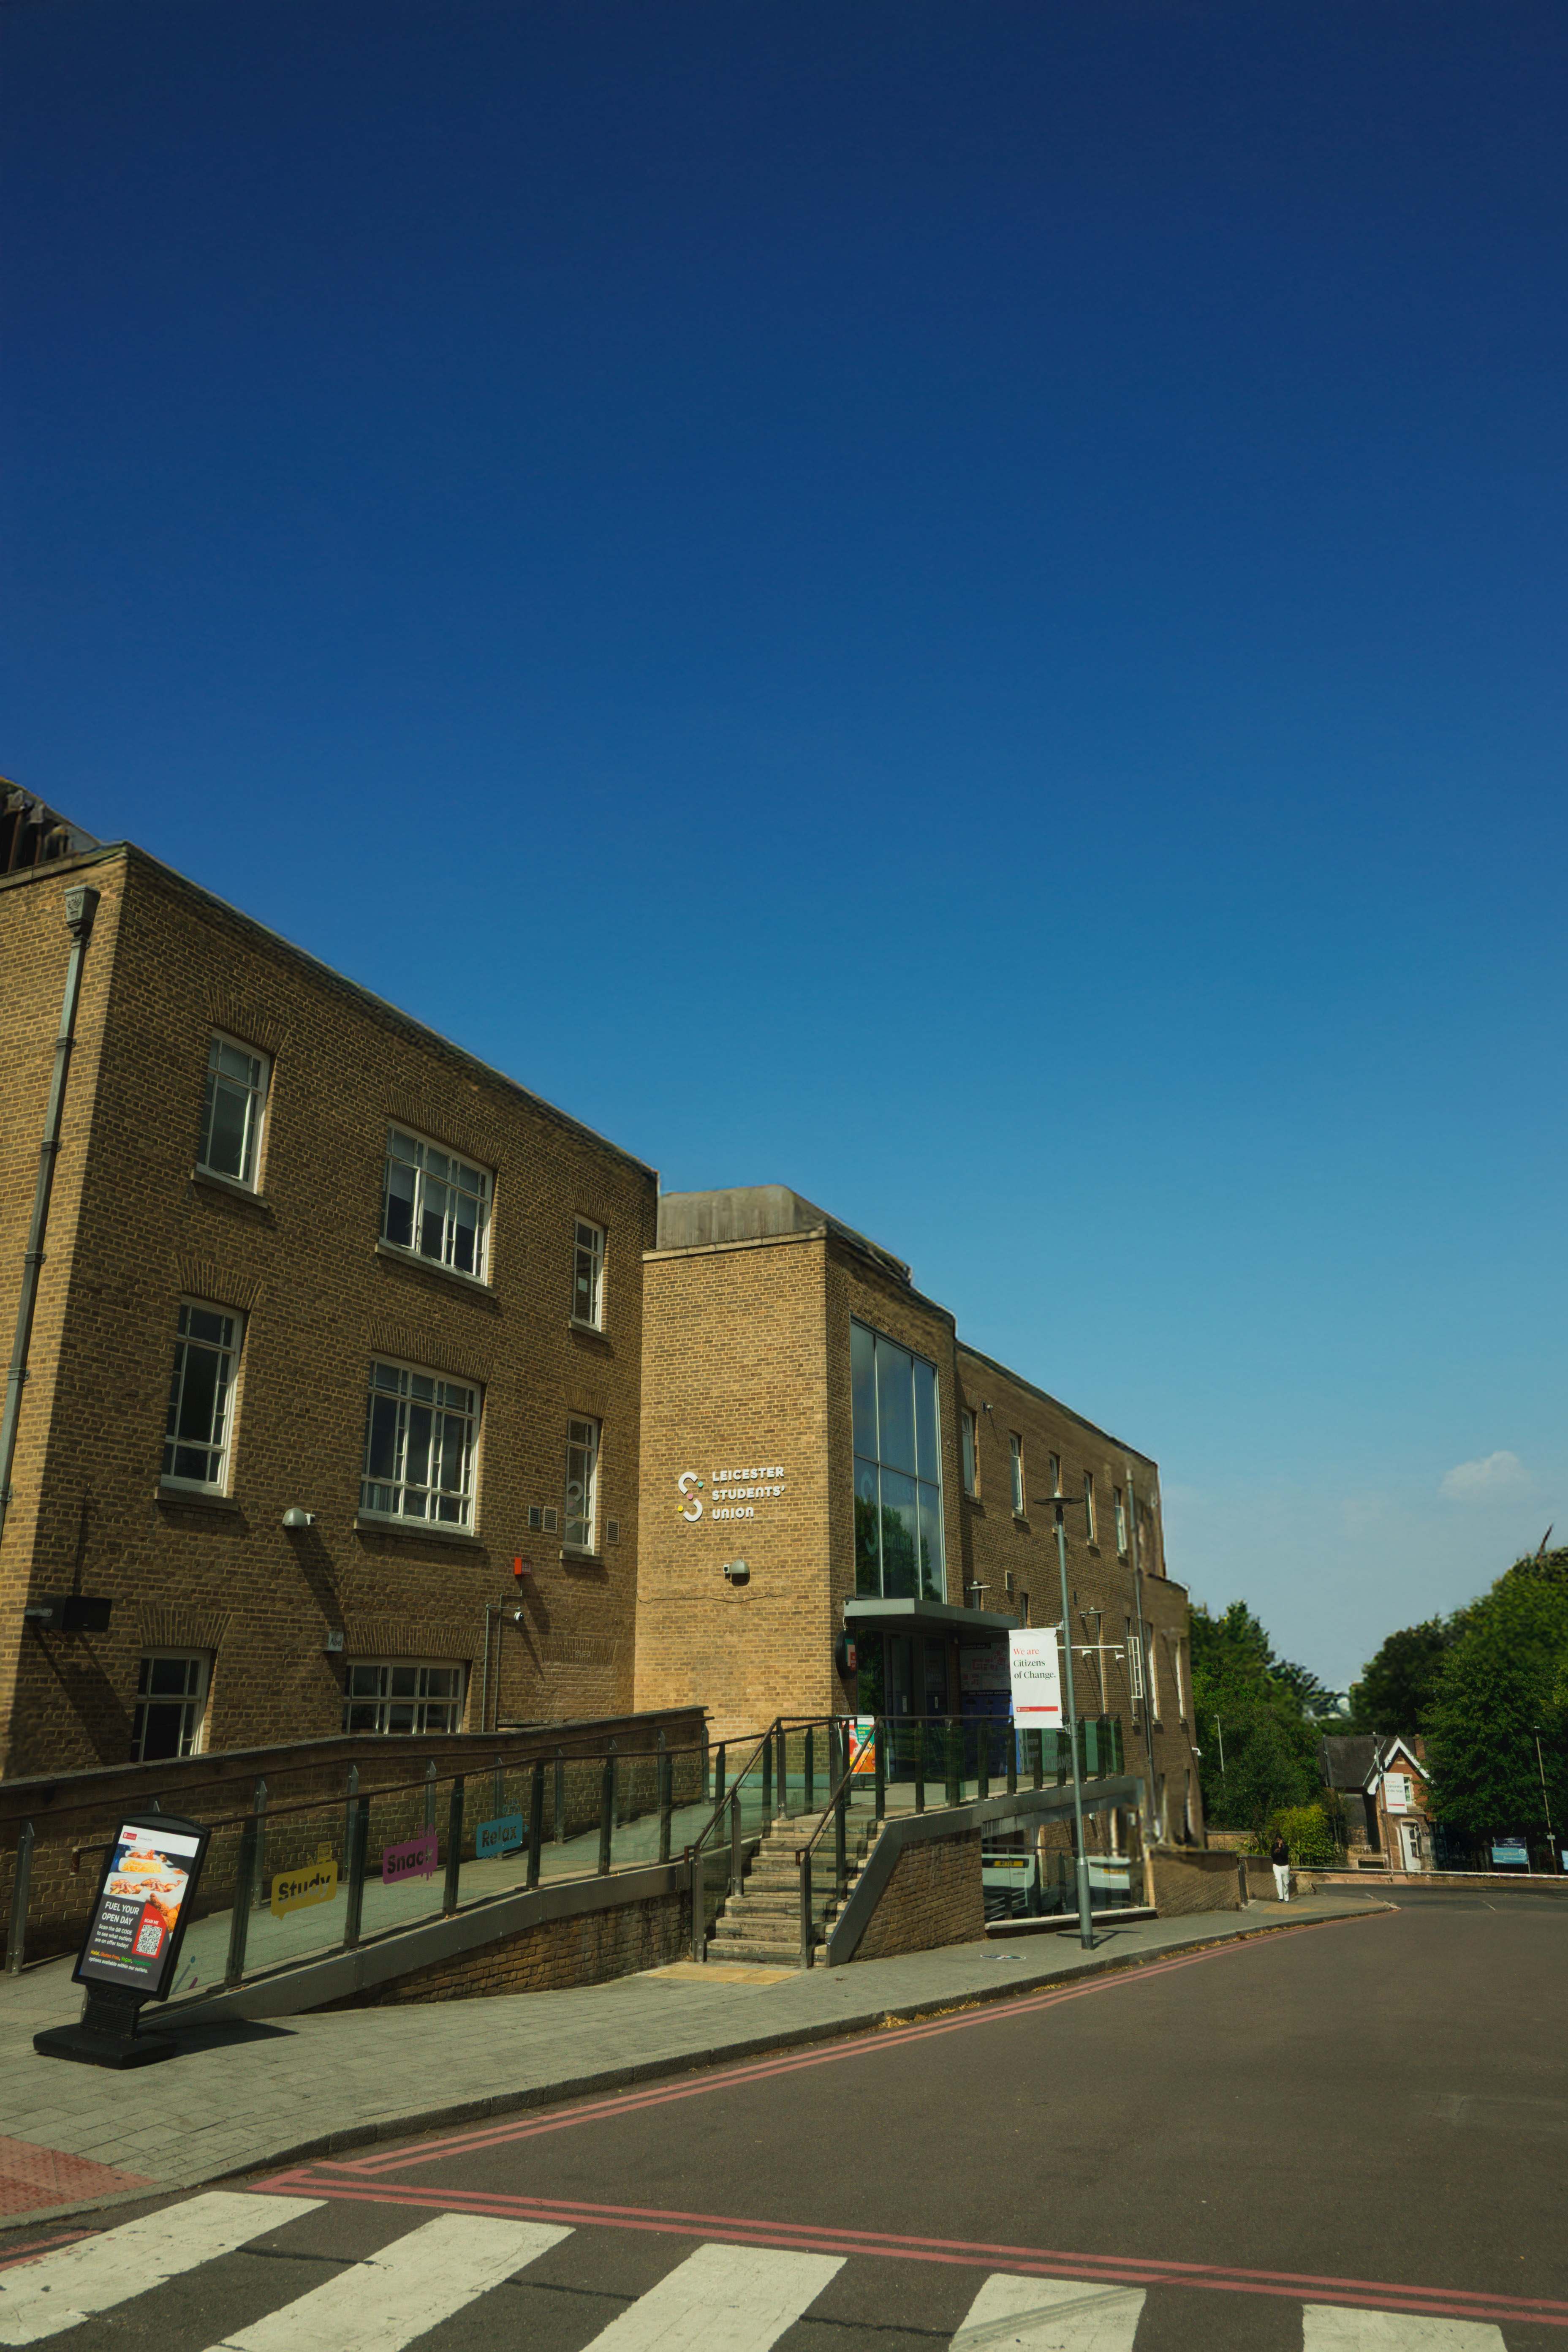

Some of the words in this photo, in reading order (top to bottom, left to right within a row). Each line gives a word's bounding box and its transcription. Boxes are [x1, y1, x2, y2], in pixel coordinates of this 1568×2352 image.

[712, 1467, 784, 1481] LEICESTER
[712, 1486, 785, 1500] STUDENTS'
[712, 1507, 754, 1519] UNION
[330, 1638, 342, 1646] Abel
[1014, 1671, 1022, 1679] of
[1024, 1671, 1056, 1680] Change.
[1045, 1735, 1059, 1750] MAIN
[482, 1825, 517, 1848] Relax
[387, 1844, 434, 1874] Snack
[278, 1873, 331, 1904] Study
[105, 1901, 121, 1911] FUEL
[122, 1904, 140, 1915] YOUR
[101, 1912, 120, 1923] OPEN
[120, 1916, 133, 1925] DAY
[133, 1959, 152, 1967] Vegetarian
